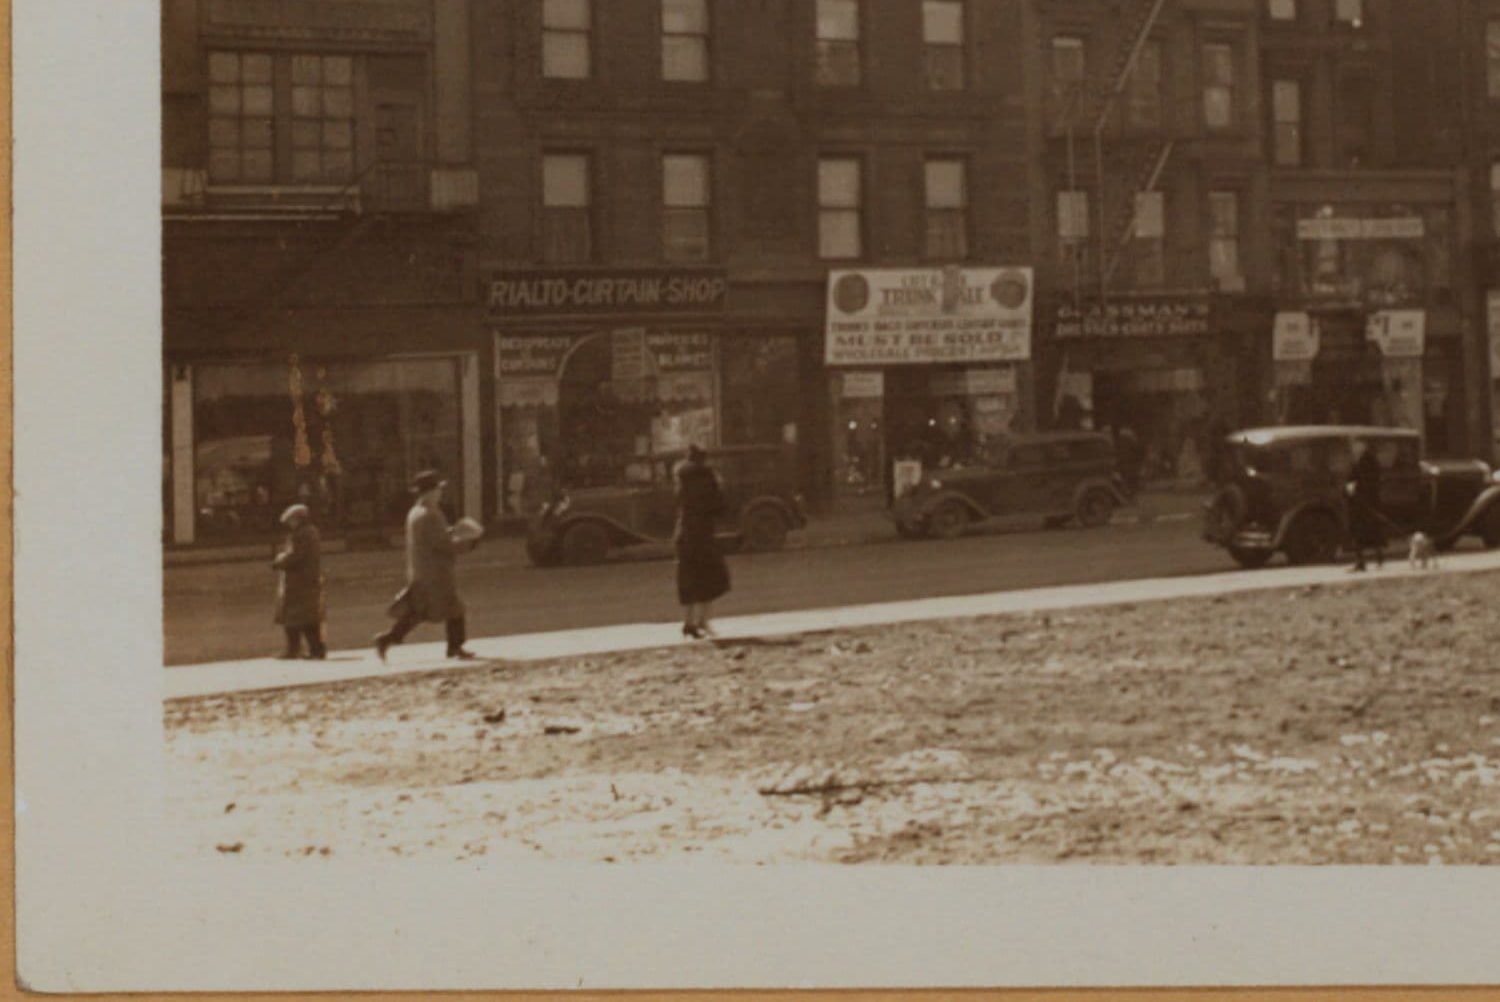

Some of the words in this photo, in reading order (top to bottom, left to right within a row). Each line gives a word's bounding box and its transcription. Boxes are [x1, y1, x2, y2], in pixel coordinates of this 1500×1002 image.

[880, 288, 938, 305] TRUNK
[835, 334, 902, 347] MUST
[909, 333, 934, 346] BE
[943, 331, 1003, 345] SOLD
